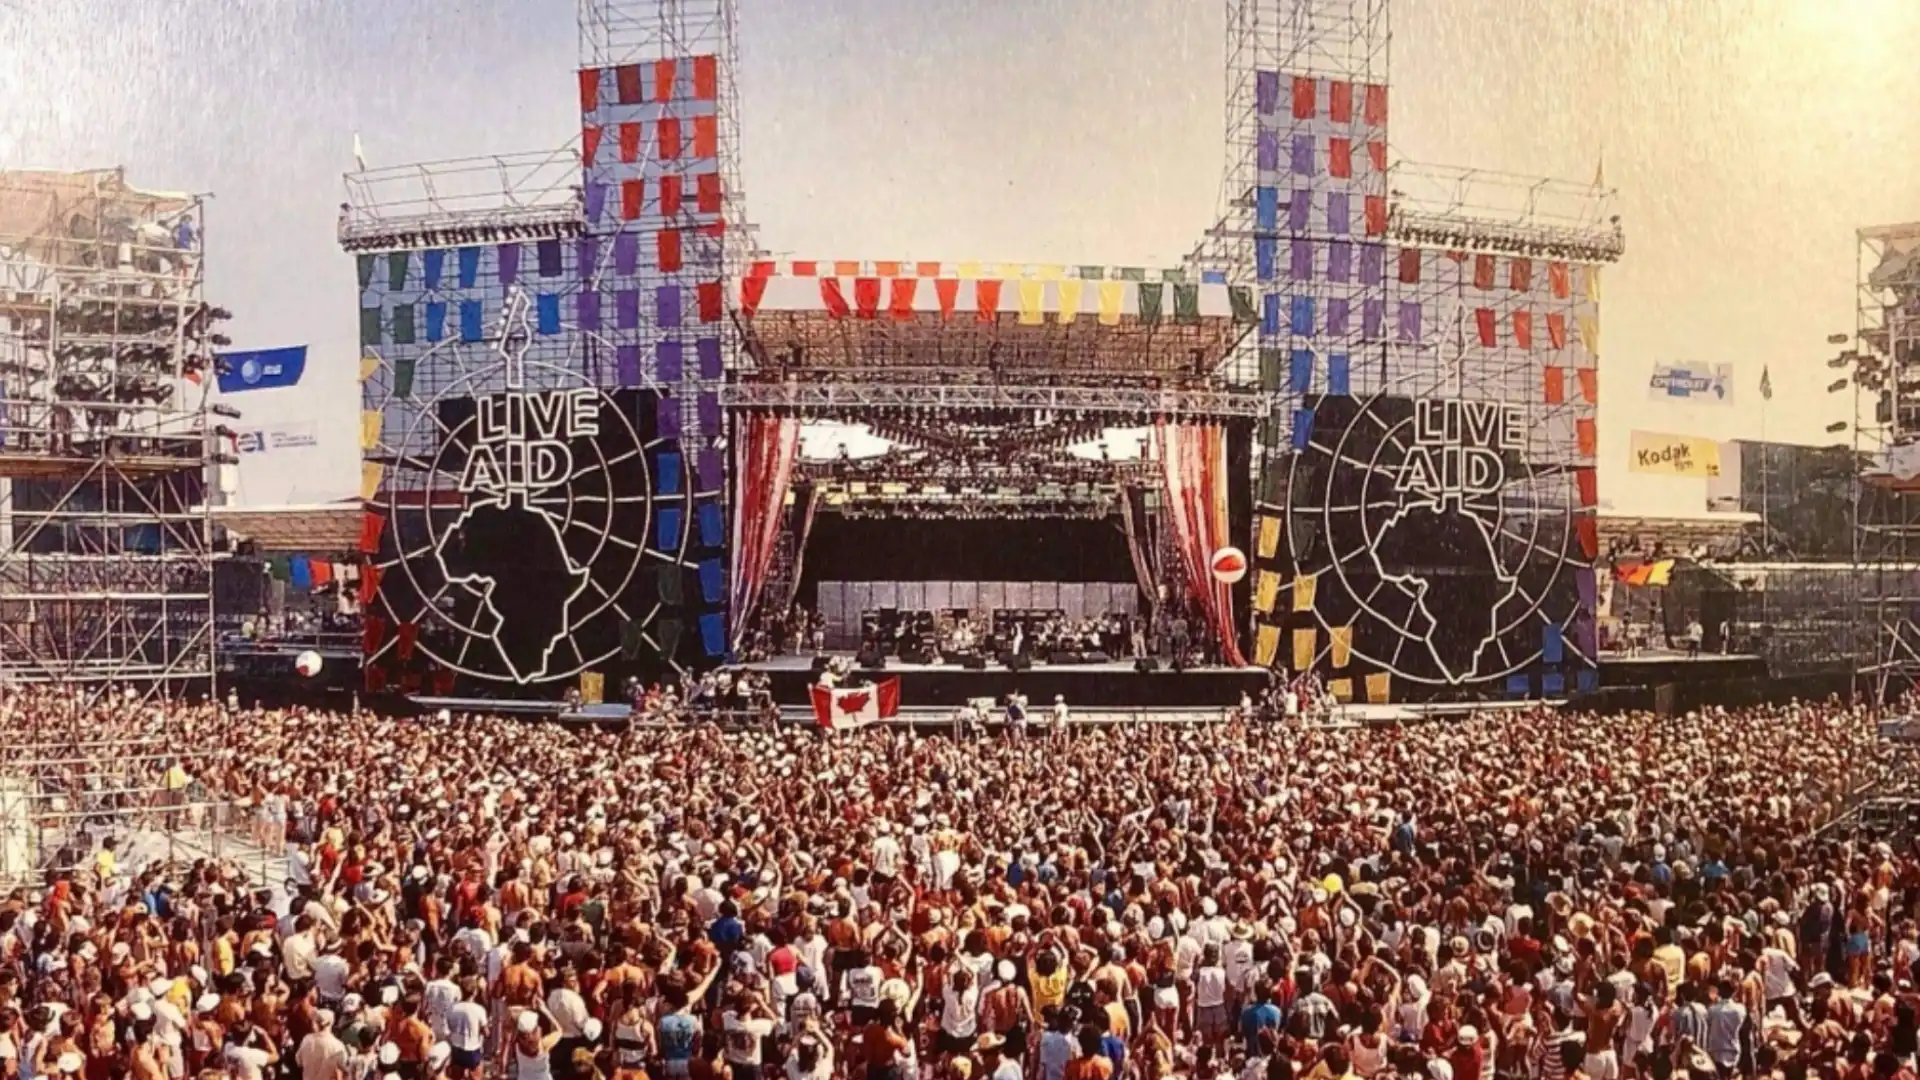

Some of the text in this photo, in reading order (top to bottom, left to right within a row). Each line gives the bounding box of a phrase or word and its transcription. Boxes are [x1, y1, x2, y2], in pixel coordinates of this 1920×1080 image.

[477, 387, 599, 443] LIVE
[1415, 398, 1528, 451] LIVE
[458, 440, 573, 493] AID
[1394, 446, 1504, 494] AID
[1637, 443, 1691, 467] Kodak
